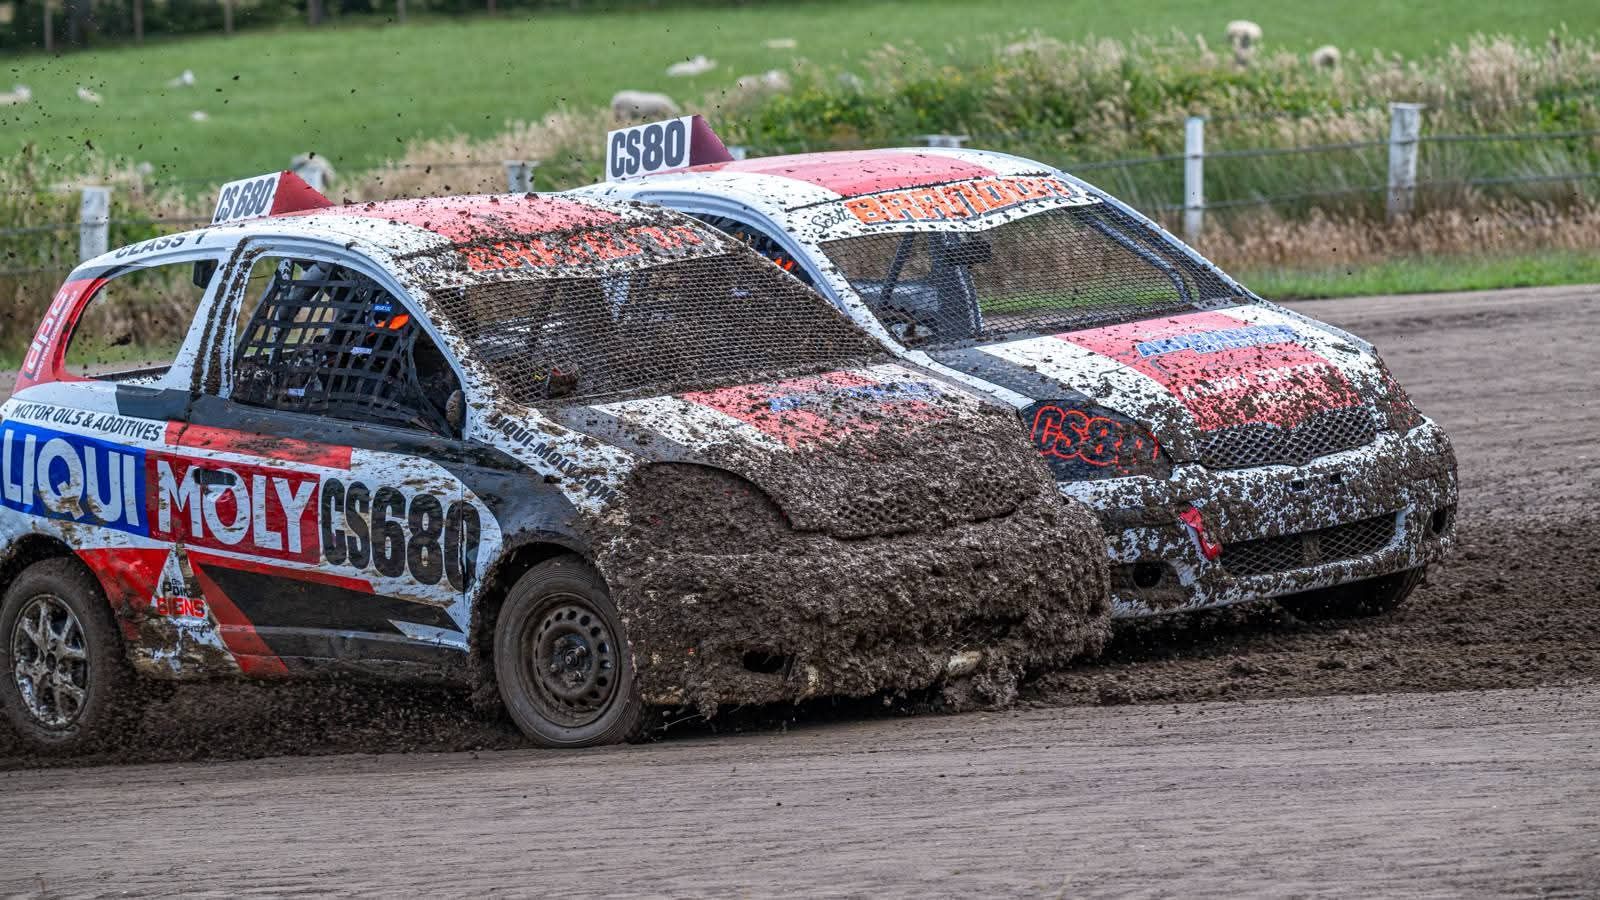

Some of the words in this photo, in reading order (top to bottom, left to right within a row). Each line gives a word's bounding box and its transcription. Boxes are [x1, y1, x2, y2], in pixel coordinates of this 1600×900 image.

[610, 120, 686, 178] CS80
[214, 185, 240, 223] CS
[232, 177, 276, 219] 680
[811, 207, 854, 234] Scott
[115, 235, 186, 258] CLASS
[10, 403, 54, 421] MOTOR
[53, 406, 85, 426] OILS
[81, 413, 95, 427] &
[92, 415, 163, 441] ADDITIVES
[2, 428, 140, 527] LIQUI
[156, 459, 319, 554] MOLY
[320, 476, 482, 593] CS680
